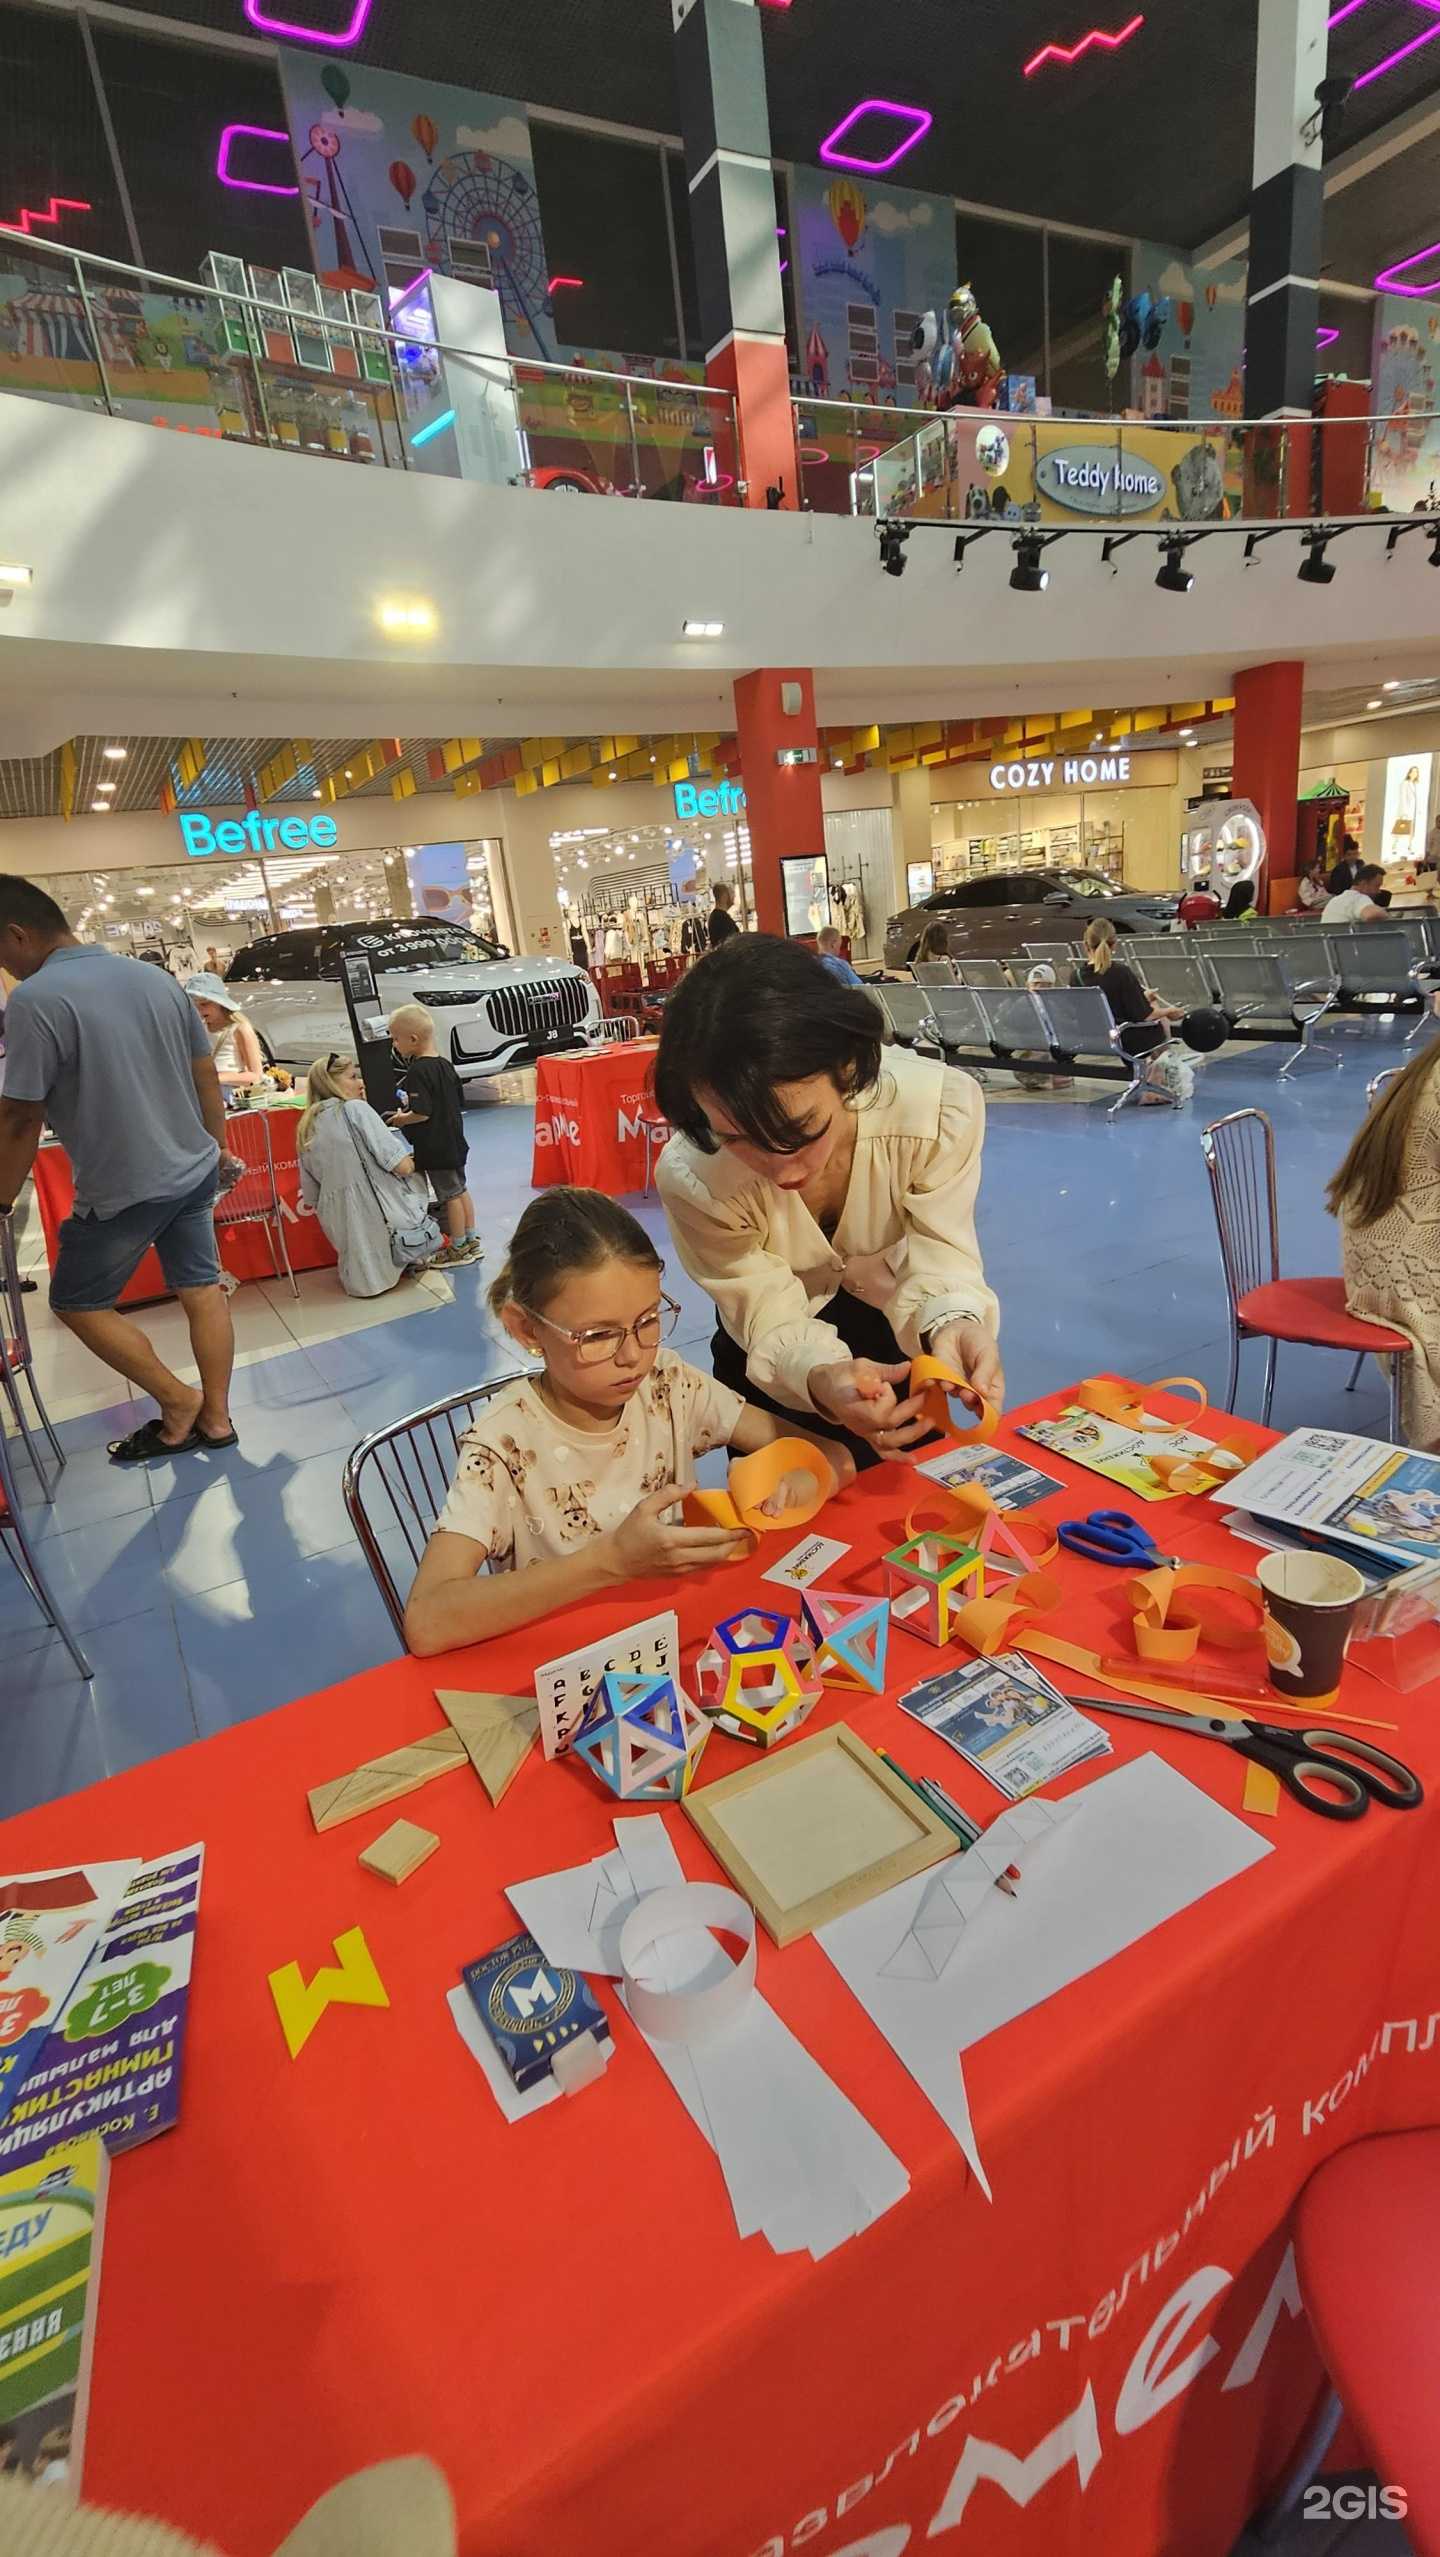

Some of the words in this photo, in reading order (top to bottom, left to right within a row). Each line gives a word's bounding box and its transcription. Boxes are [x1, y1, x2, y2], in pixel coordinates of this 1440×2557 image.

[1053, 458, 1110, 496] Teddy
[990, 762, 1055, 790] COZY
[1064, 757, 1131, 785] HOME
[179, 809, 338, 857] Befree
[604, 1658, 616, 1672] C
[629, 1649, 641, 1663] D
[654, 1637, 669, 1652] E
[99, 1971, 137, 2001] ЛЕТ
[2, 2040, 174, 2129] ГИМНАСТИК
[18, 2040, 120, 2097] малыш
